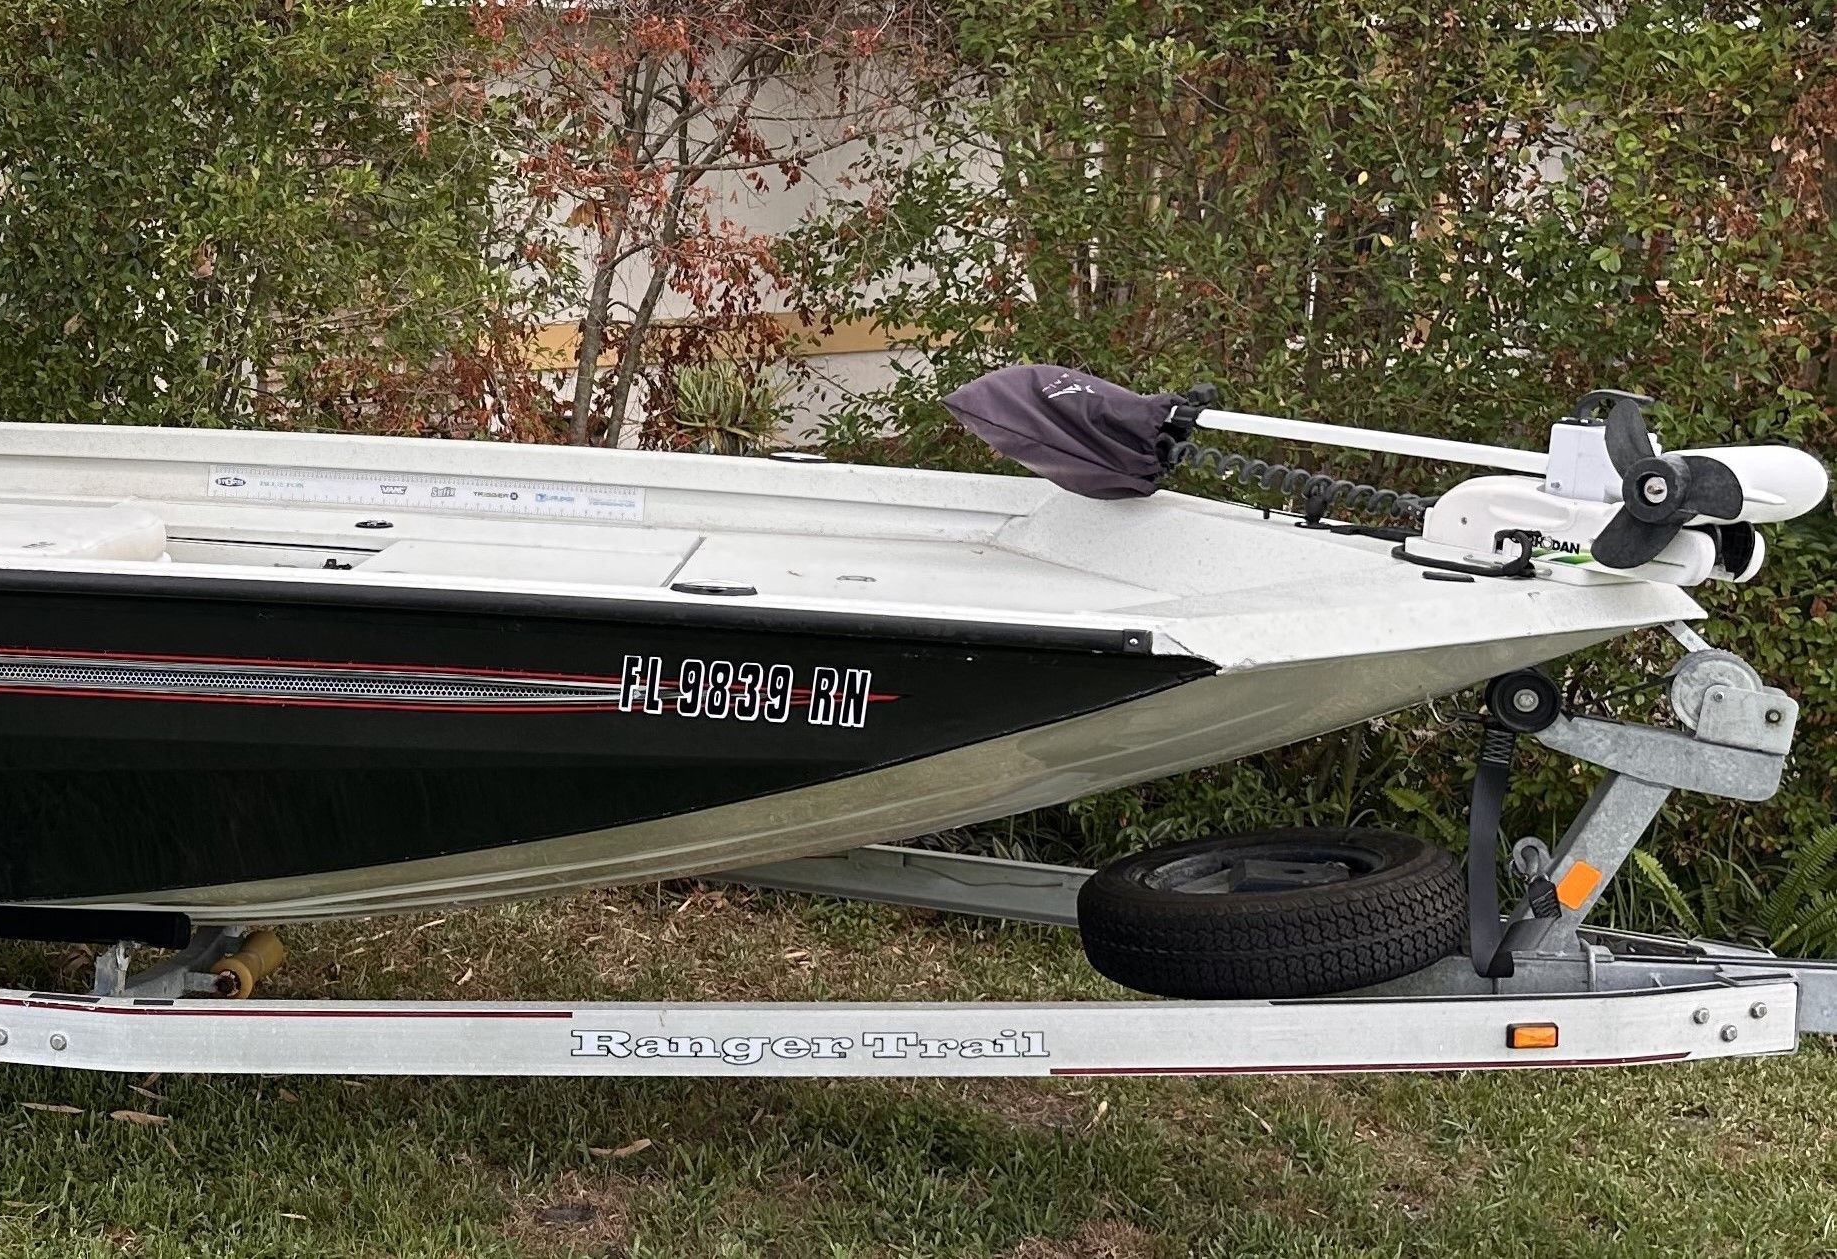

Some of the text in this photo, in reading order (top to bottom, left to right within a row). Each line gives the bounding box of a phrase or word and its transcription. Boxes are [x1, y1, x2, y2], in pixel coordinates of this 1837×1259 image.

[618, 654, 872, 728] FL 9839 RN
[570, 1029, 1051, 1066] Ranger Trail
